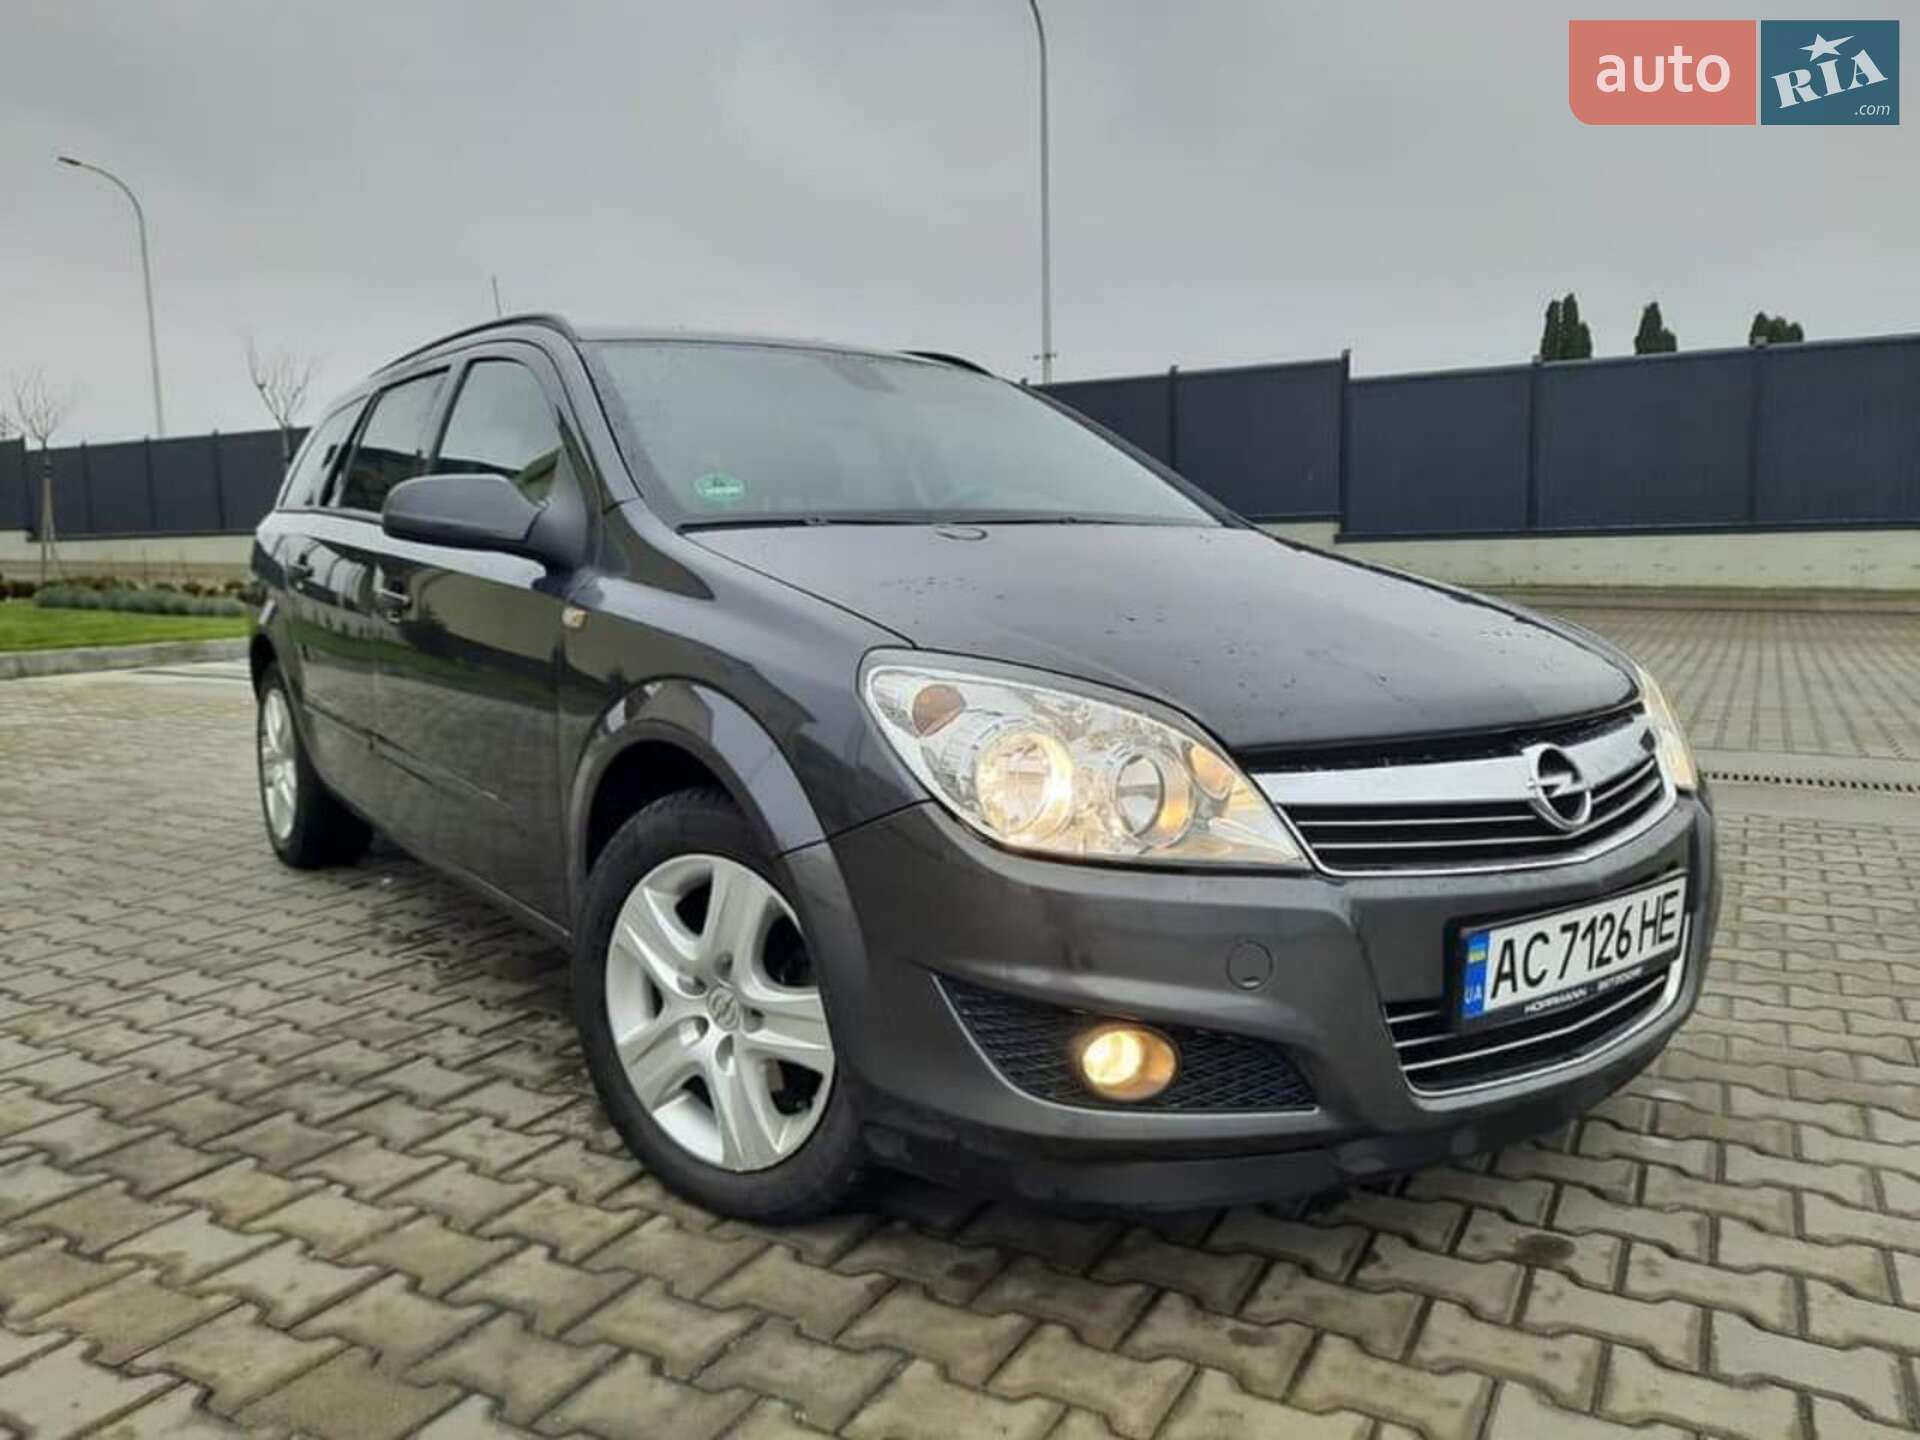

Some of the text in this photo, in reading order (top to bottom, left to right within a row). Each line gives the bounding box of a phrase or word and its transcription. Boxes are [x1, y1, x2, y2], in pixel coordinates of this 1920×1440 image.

[1490, 889, 1679, 1000] AC 7126 HE
[1464, 985, 1483, 1004] UA
